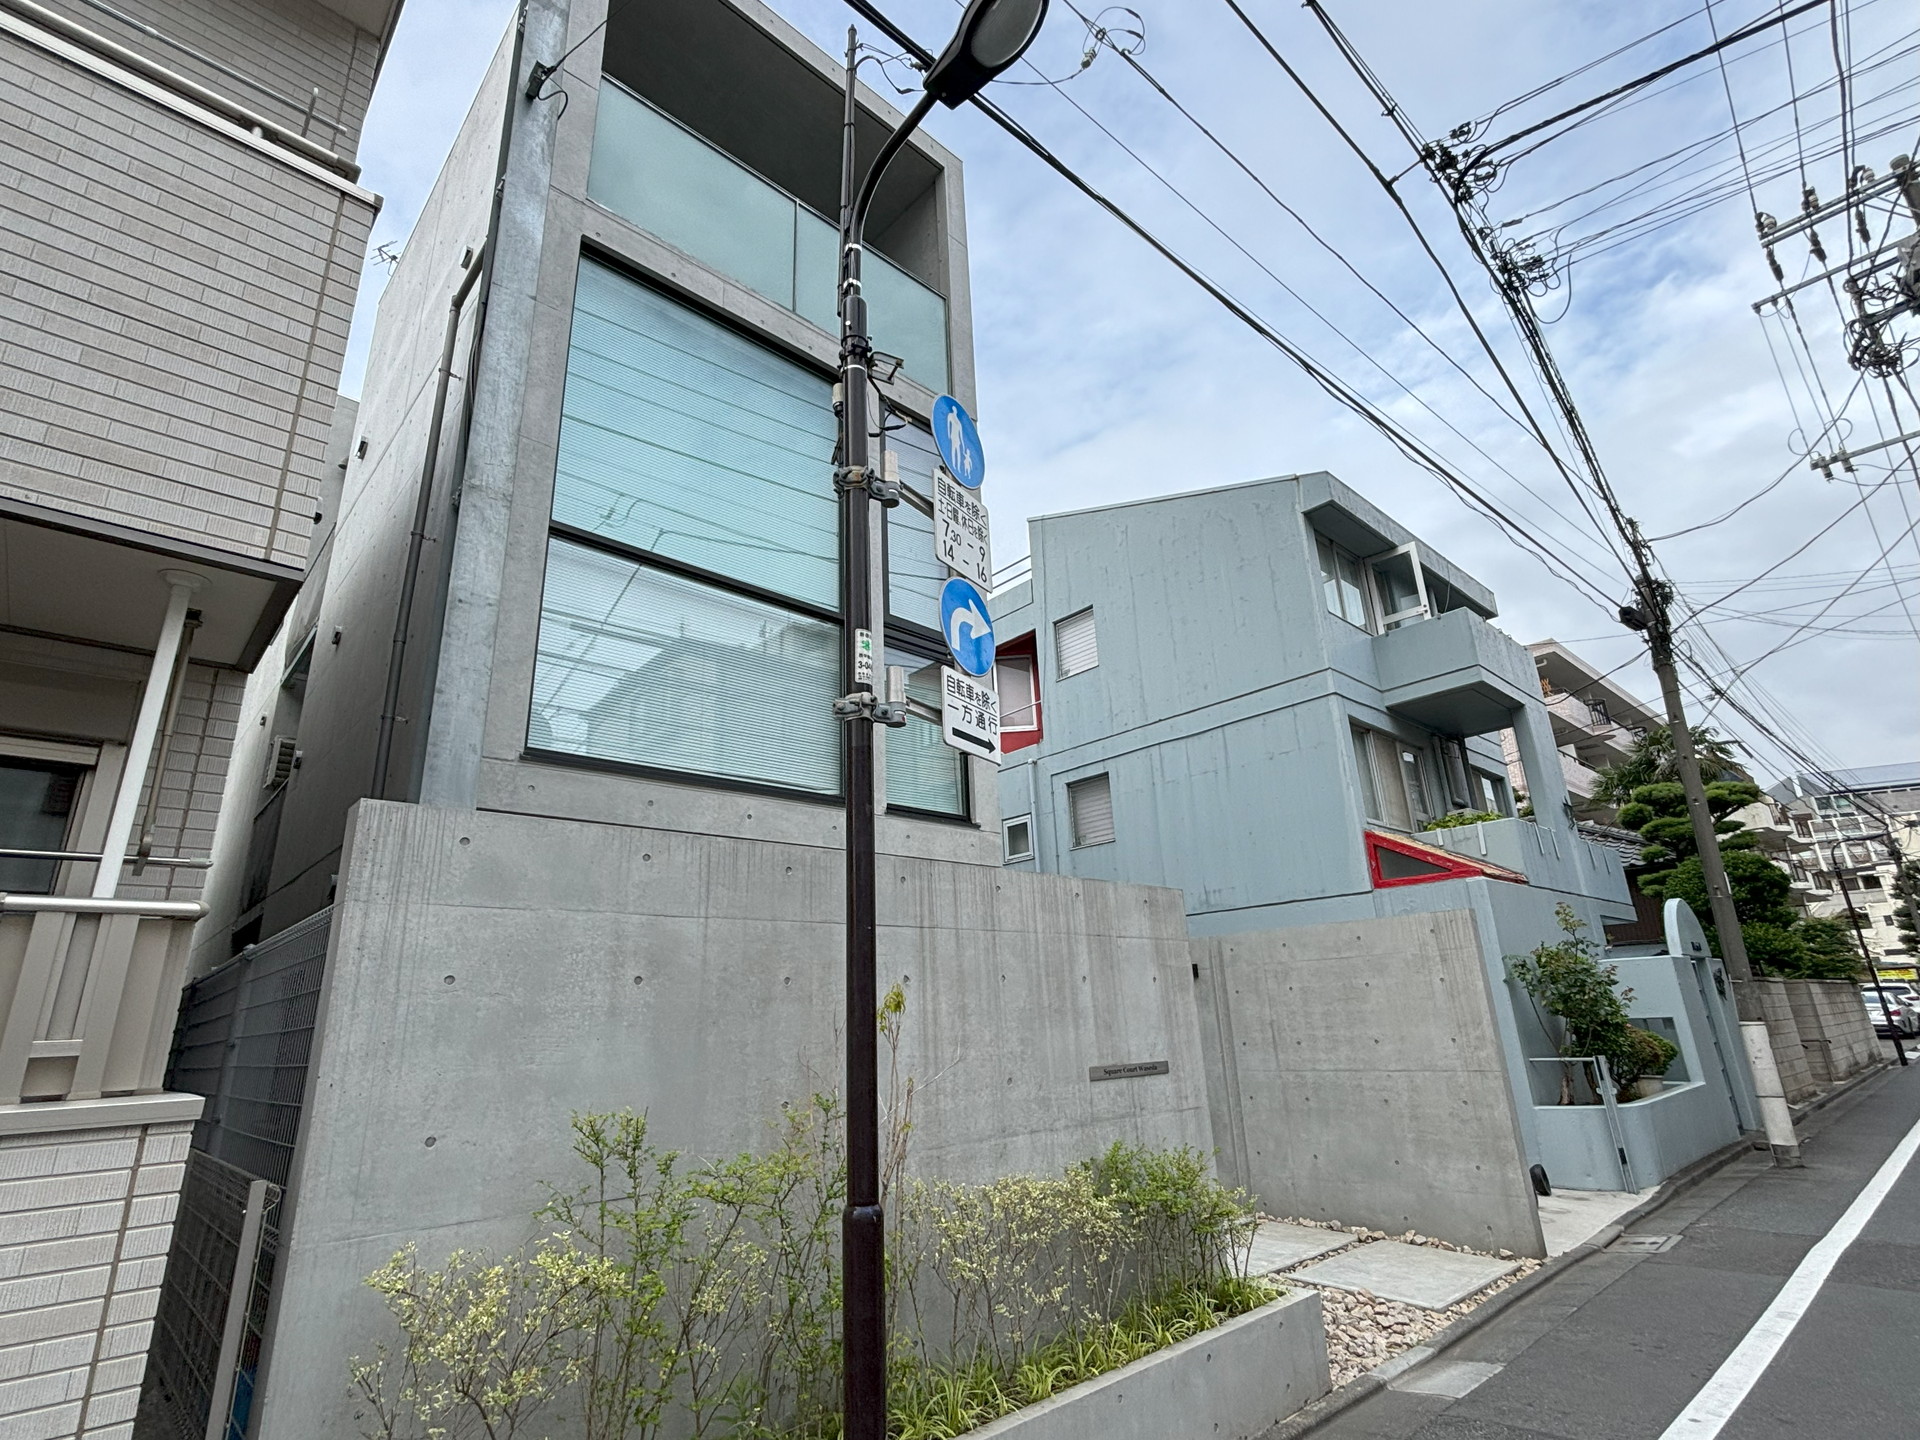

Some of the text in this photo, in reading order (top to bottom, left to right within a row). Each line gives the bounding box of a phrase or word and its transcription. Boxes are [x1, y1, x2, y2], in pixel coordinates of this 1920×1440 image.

[937, 476, 987, 526] 自転車を除く
[943, 540, 954, 562] 14
[977, 562, 987, 583] 16
[979, 545, 986, 562] 9
[947, 674, 997, 713] 自転車を除く
[947, 703, 998, 735] 一方通行
[1103, 1068, 1122, 1076] Square
[1138, 1064, 1158, 1072] Waseda
